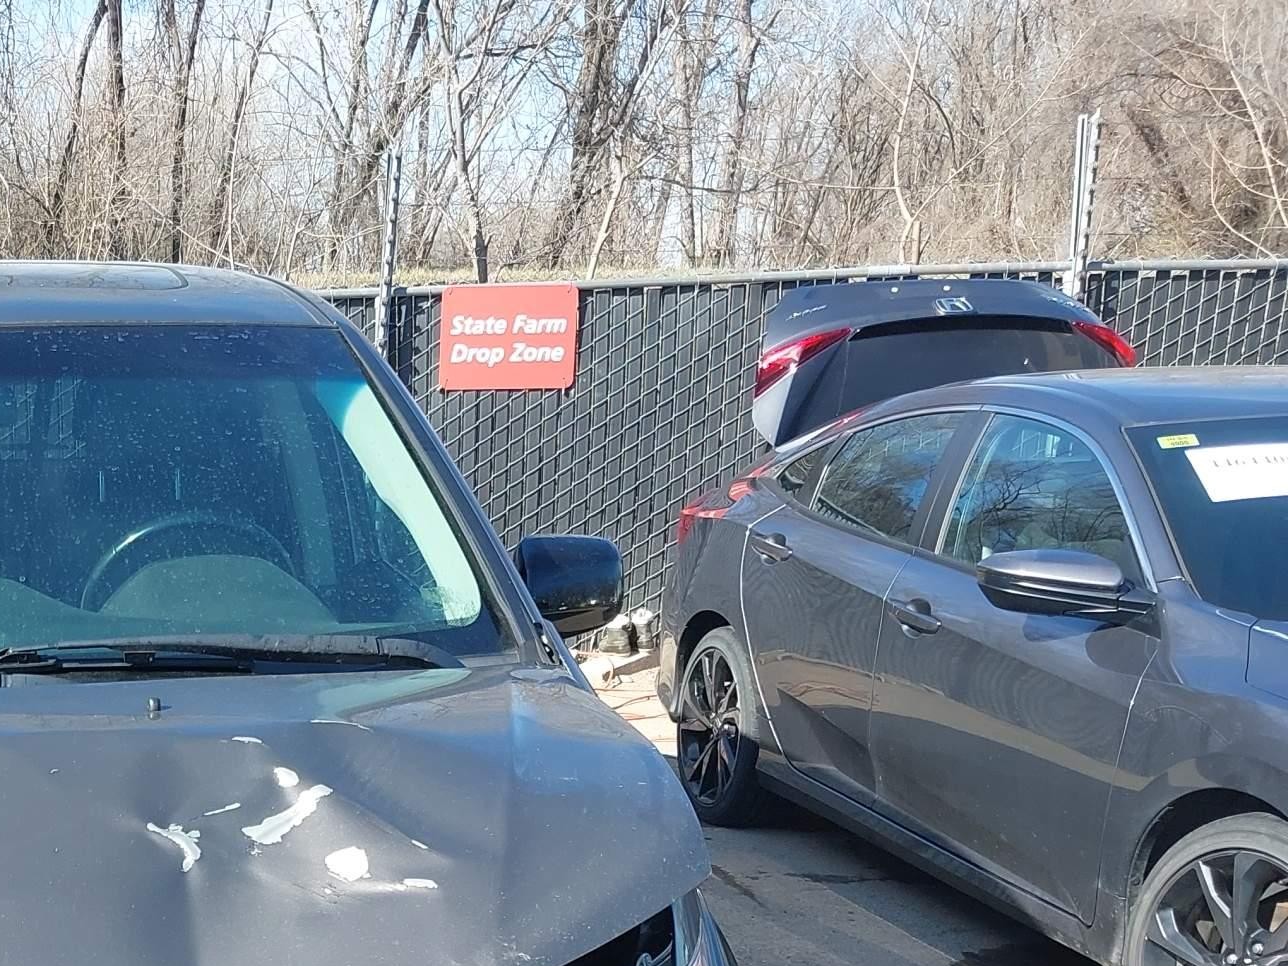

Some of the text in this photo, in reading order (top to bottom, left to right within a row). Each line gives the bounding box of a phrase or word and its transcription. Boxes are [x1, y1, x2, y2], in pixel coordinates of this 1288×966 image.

[450, 314, 567, 336] State Farm
[450, 342, 565, 368] Drop Zone
